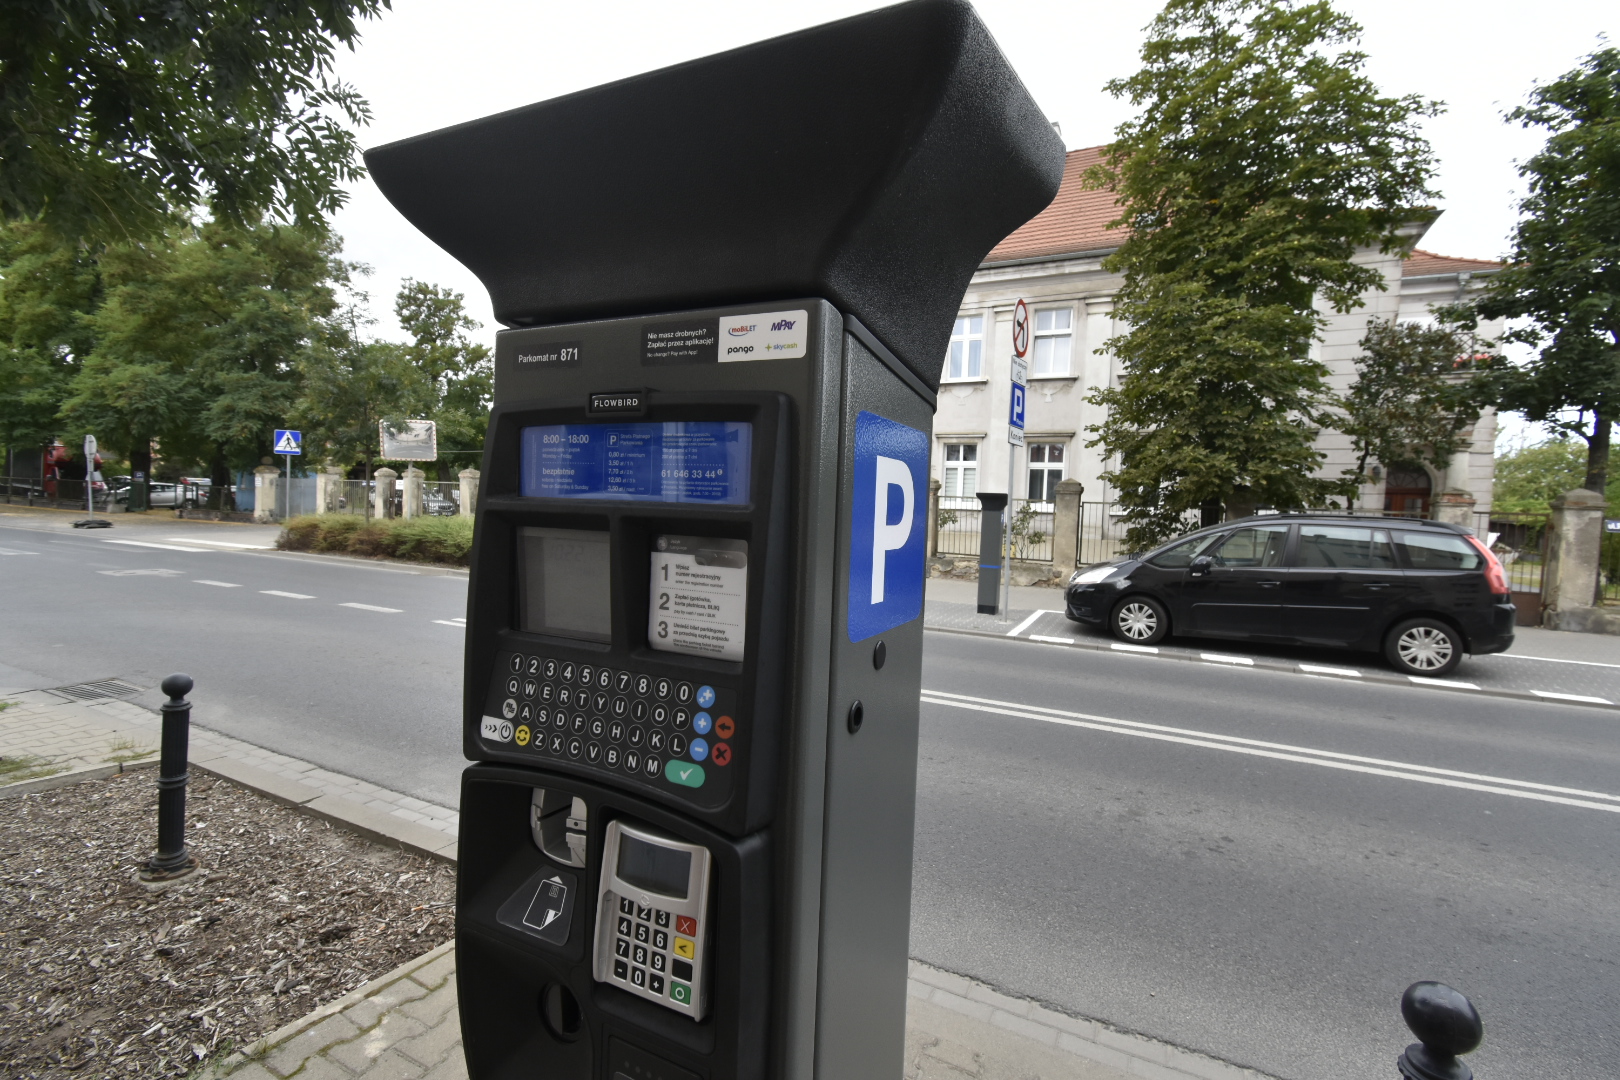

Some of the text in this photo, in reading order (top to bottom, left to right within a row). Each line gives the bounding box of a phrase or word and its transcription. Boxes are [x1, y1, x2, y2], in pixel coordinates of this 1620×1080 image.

[675, 329, 706, 338] drobnych?
[647, 340, 666, 349] Zapłać
[685, 337, 714, 346] aplikację!
[728, 346, 754, 355] pango
[518, 354, 549, 363] Parkomat
[560, 348, 578, 361] 871
[594, 399, 638, 407] FLOWBIRD
[1013, 388, 1023, 421] P
[543, 435, 560, 443] 8:00
[568, 435, 589, 443] 18:00
[610, 435, 616, 445] P
[543, 468, 574, 476] bezpłatnie
[692, 470, 702, 478] 33
[705, 470, 715, 478] 44
[871, 455, 915, 605] P
[661, 564, 668, 581] 1
[659, 593, 670, 610] 2
[658, 621, 668, 638] 3
[515, 658, 688, 700] 1 2 3 4 5 6 7 8 9 0
[510, 681, 685, 724] Q W E R T Y U I O P
[522, 707, 529, 718] A
[540, 711, 546, 721] S
[557, 714, 564, 725] D
[575, 718, 582, 728] F
[593, 722, 601, 733] G
[612, 726, 620, 738] H
[632, 731, 639, 741] J
[652, 734, 661, 746] K
[674, 739, 680, 751] L
[535, 734, 657, 773] Z X C V B N M
[624, 900, 665, 924] 1 2 3
[620, 921, 663, 947] 4 5 6
[620, 942, 661, 968] 7 8 9
[635, 971, 641, 984] 0
